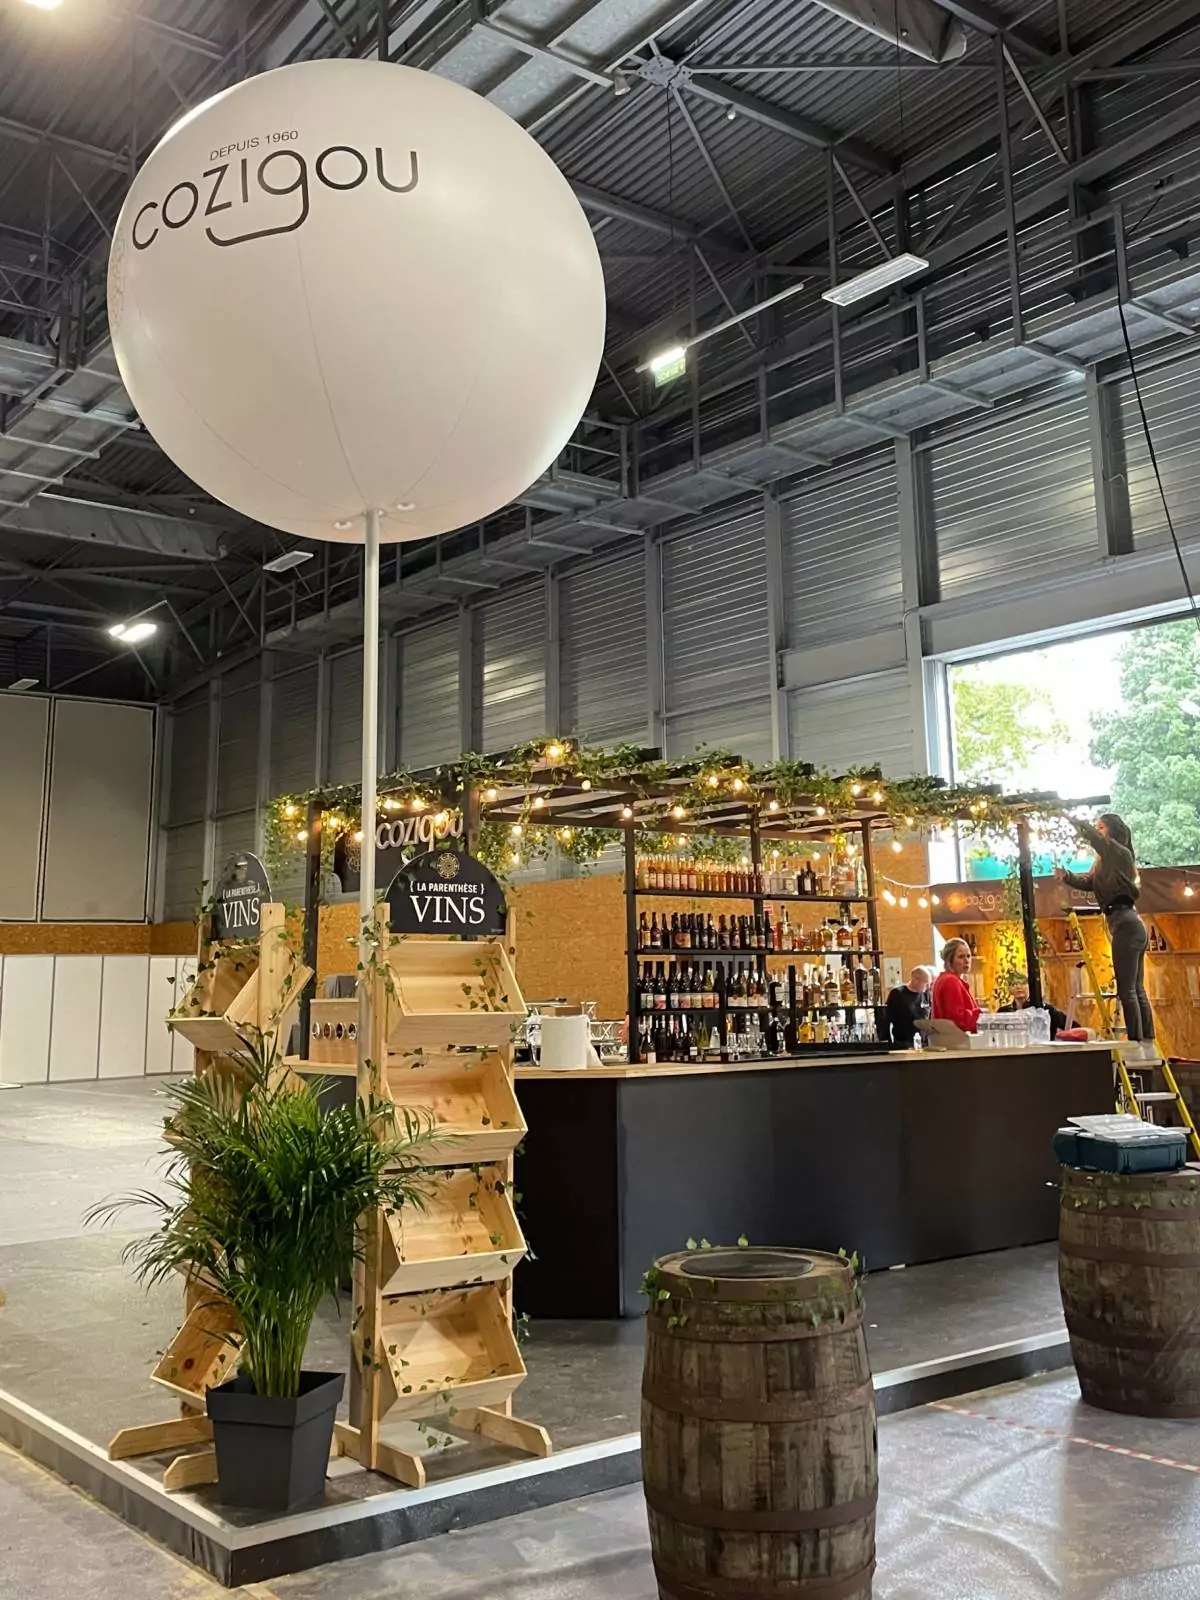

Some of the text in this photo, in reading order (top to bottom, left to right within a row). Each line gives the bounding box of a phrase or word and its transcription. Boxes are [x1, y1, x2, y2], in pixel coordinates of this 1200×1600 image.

[209, 130, 299, 161] DEPUIS 1960
[417, 882, 427, 892] LA
[428, 882, 478, 894] PARENTHÈSE
[222, 897, 260, 929] VINS
[409, 895, 486, 924] VINS
